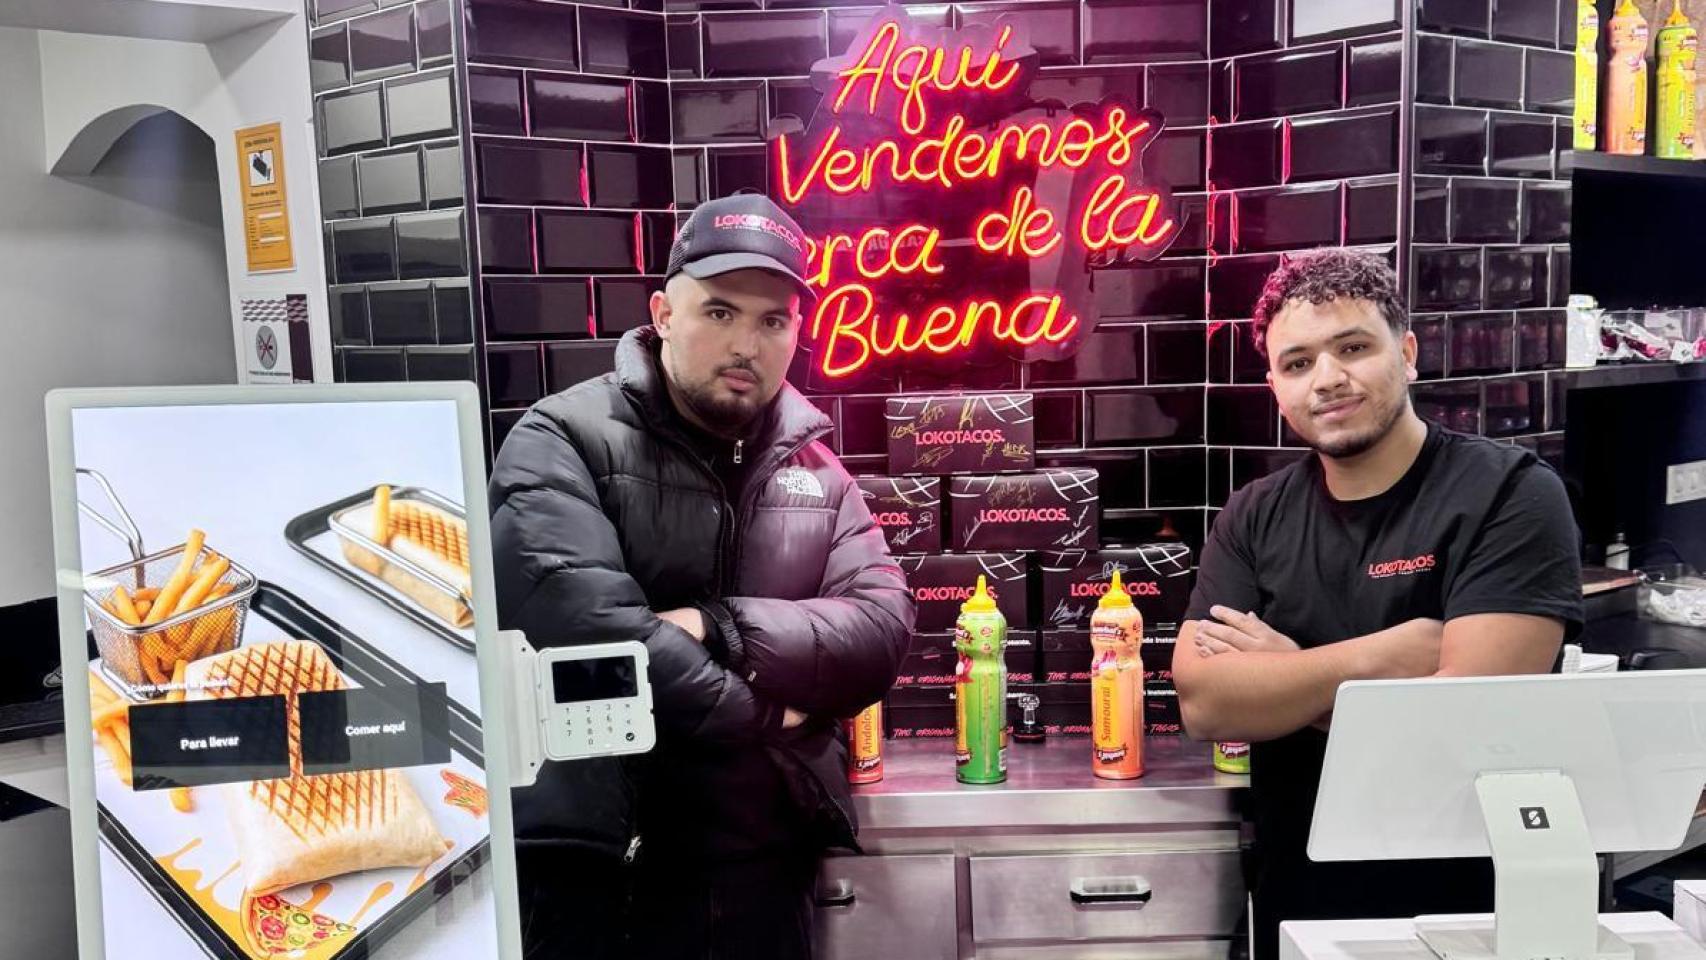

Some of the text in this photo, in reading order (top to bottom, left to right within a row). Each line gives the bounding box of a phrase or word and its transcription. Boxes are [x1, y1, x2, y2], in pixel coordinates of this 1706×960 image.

[834, 22, 1020, 135] Aquí
[779, 107, 1150, 204] Vendemos
[976, 187, 1063, 258] de
[1081, 174, 1174, 251] la
[813, 283, 1078, 377] Buena
[180, 735, 240, 750] Para llevar
[345, 720, 406, 737] Comer aquí
